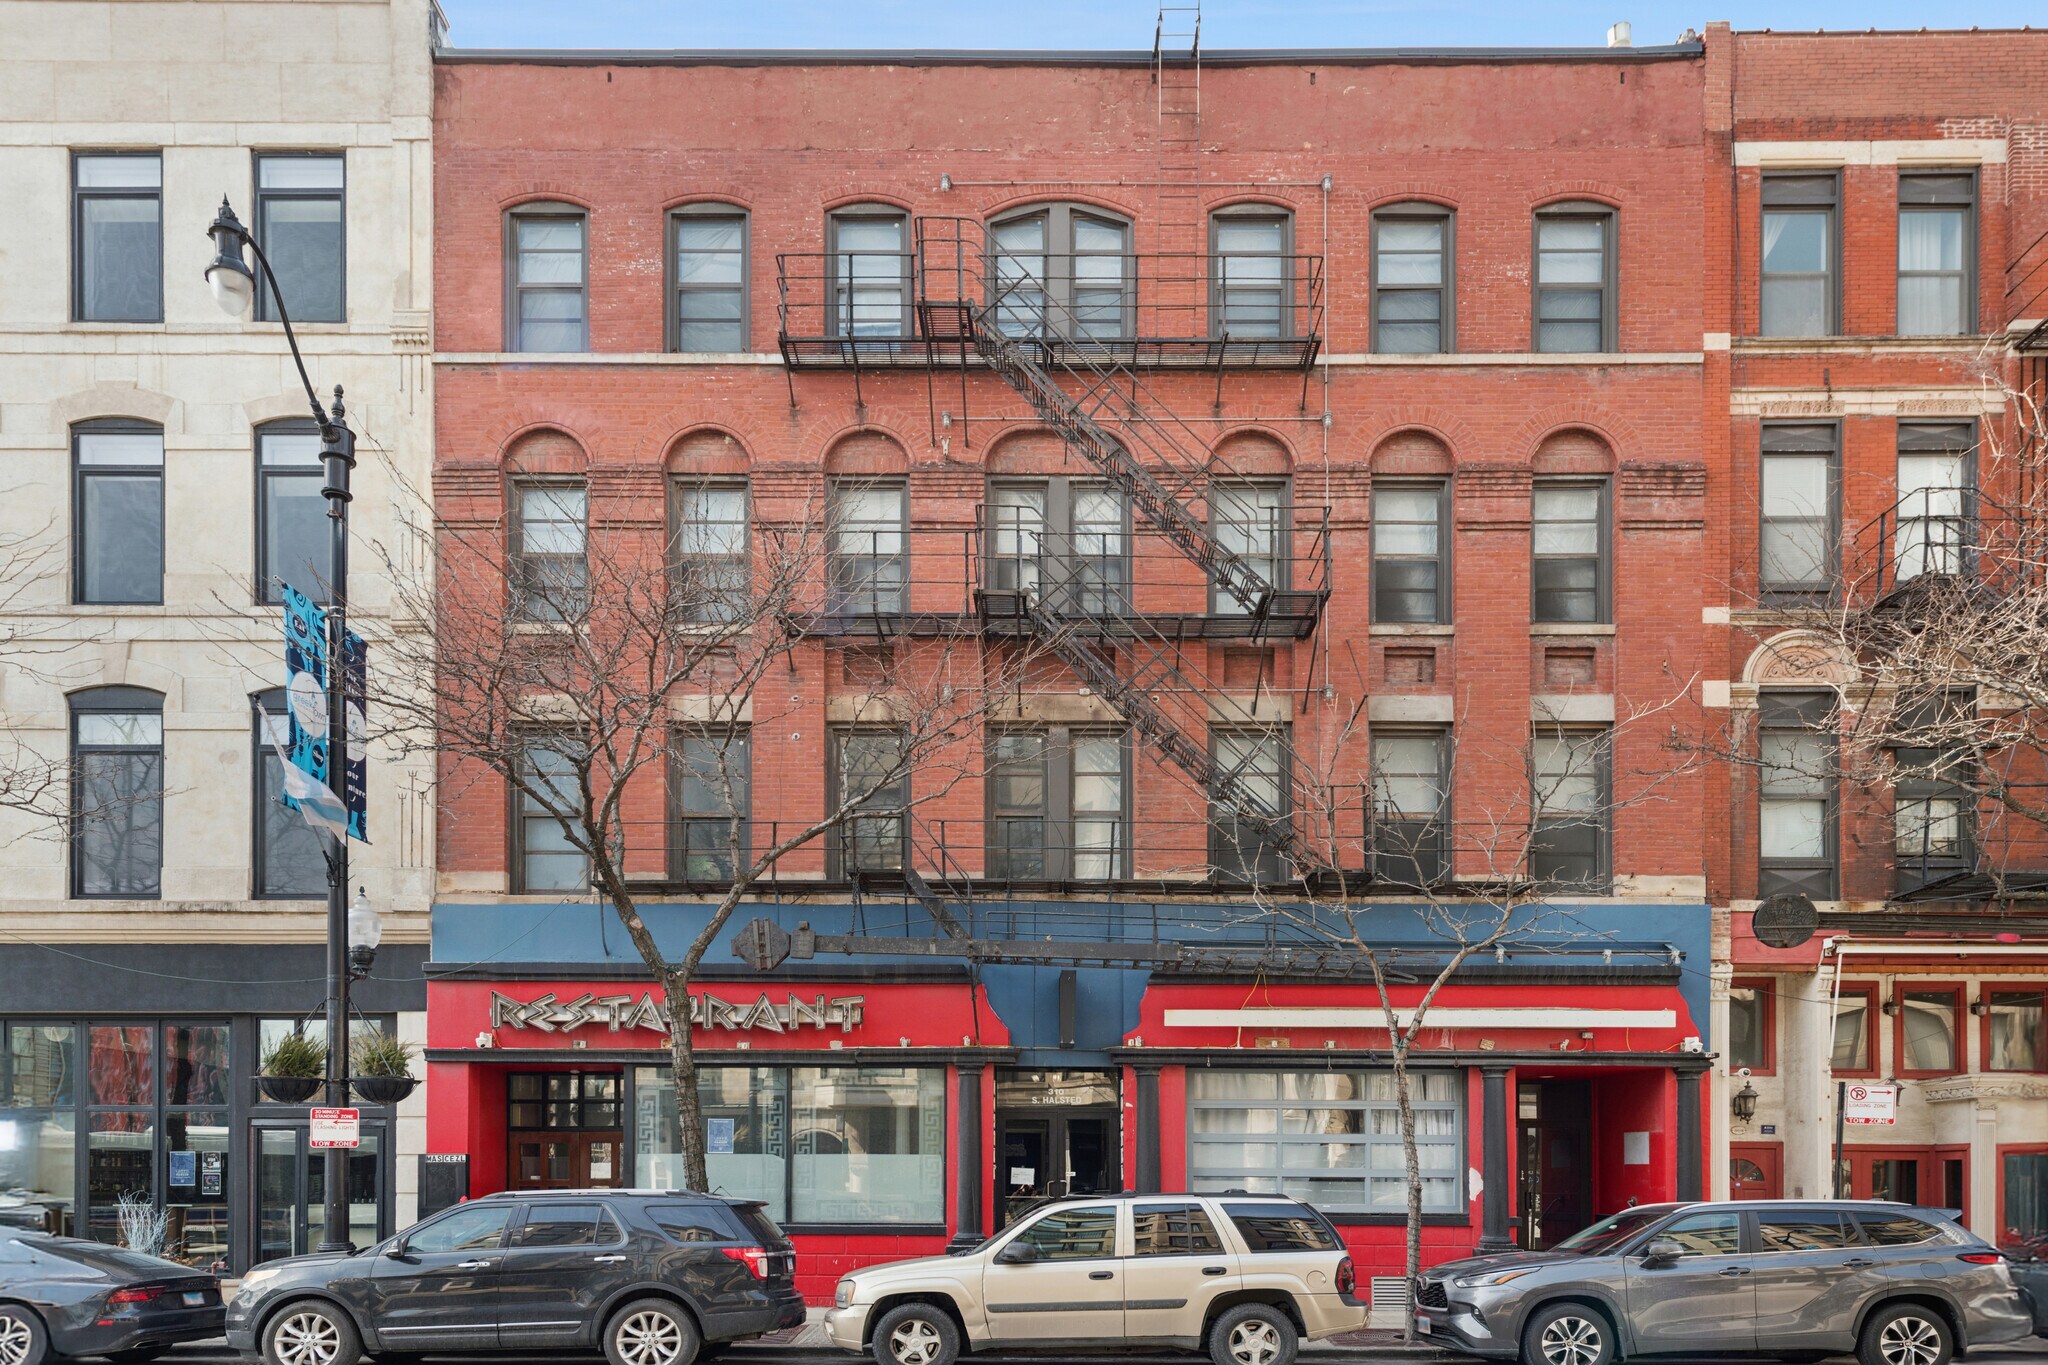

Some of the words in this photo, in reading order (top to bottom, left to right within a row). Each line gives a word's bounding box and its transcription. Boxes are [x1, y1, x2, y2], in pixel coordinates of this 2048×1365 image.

[347, 770, 359, 781] our
[1031, 1096, 1040, 1104] S.
[1042, 1096, 1082, 1104] HALSTED
